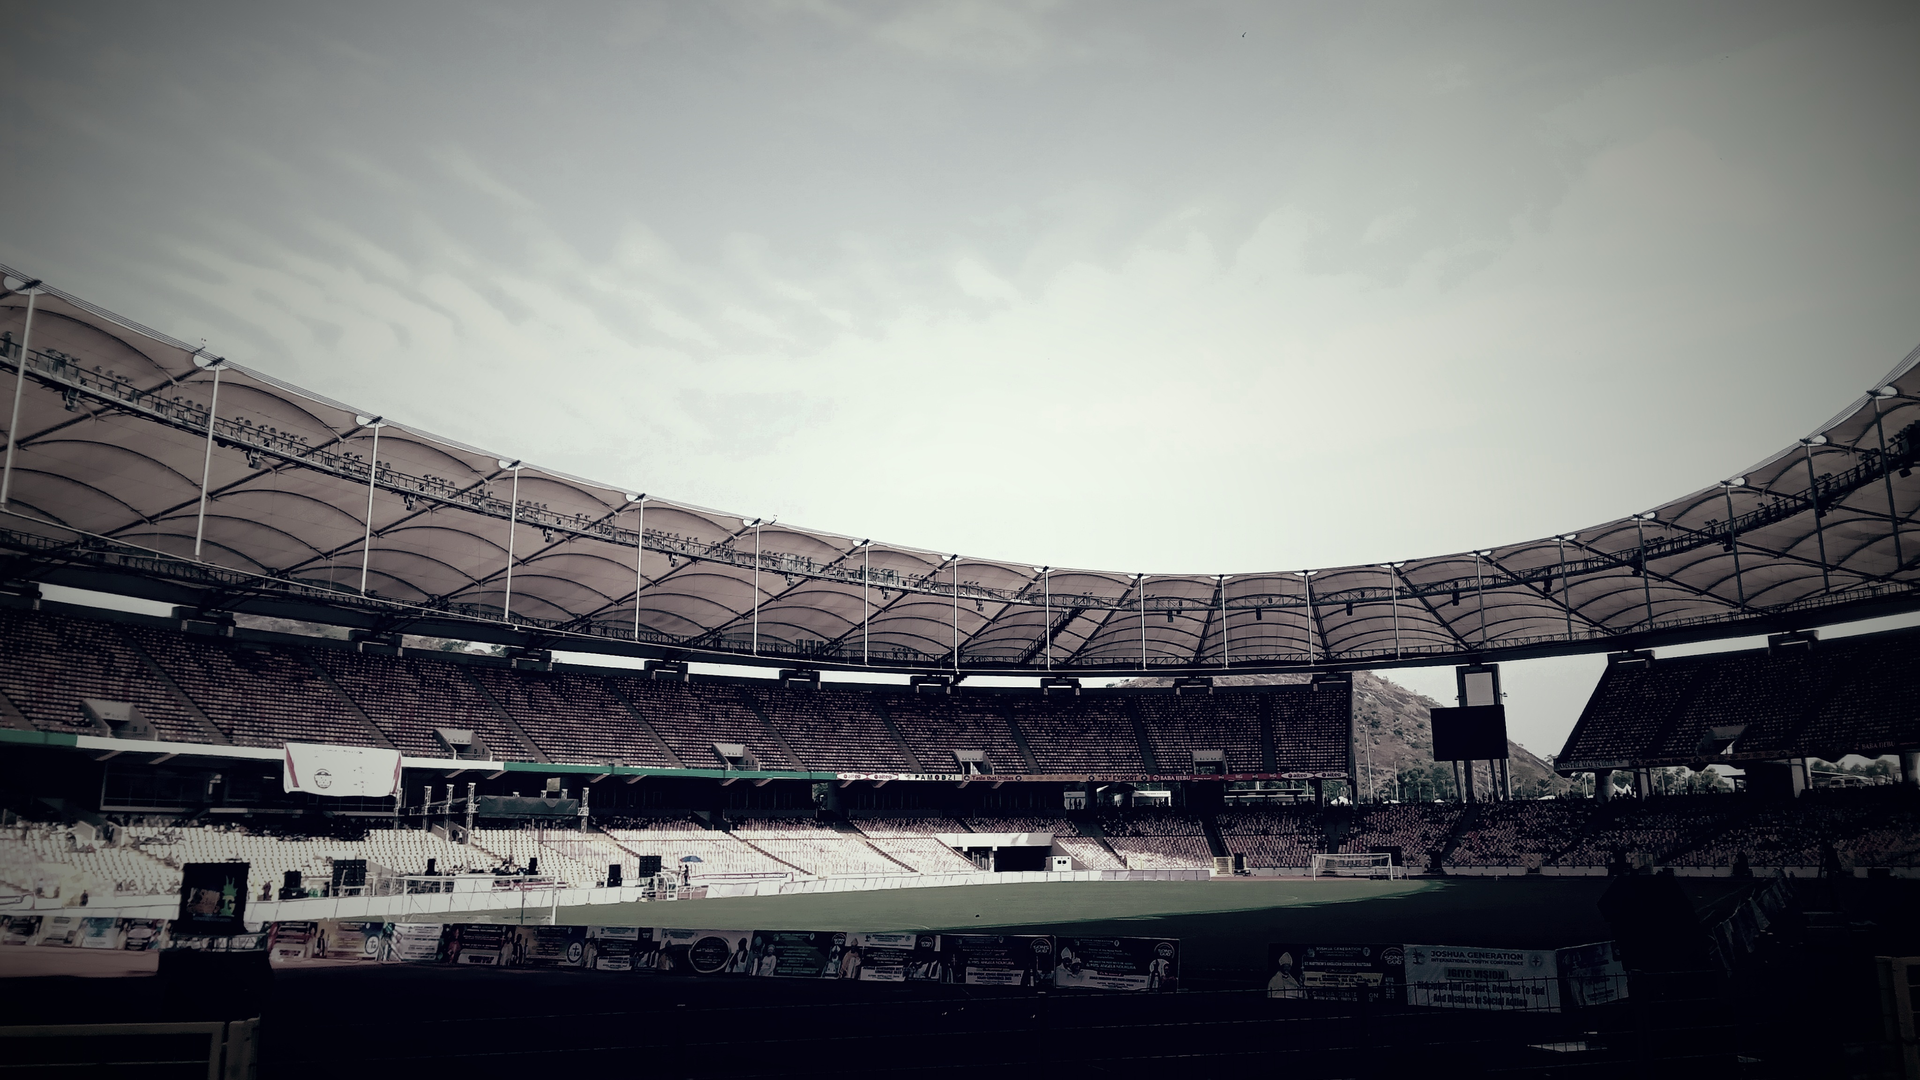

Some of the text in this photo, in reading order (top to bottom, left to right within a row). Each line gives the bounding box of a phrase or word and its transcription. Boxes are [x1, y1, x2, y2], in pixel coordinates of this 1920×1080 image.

[1430, 950, 1524, 960] JOSHUA GENERATION
[1447, 968, 1505, 979] JGIYC VISION
[1521, 985, 1531, 994] To
[1531, 986, 1545, 995] God
[1433, 994, 1447, 1002] And
